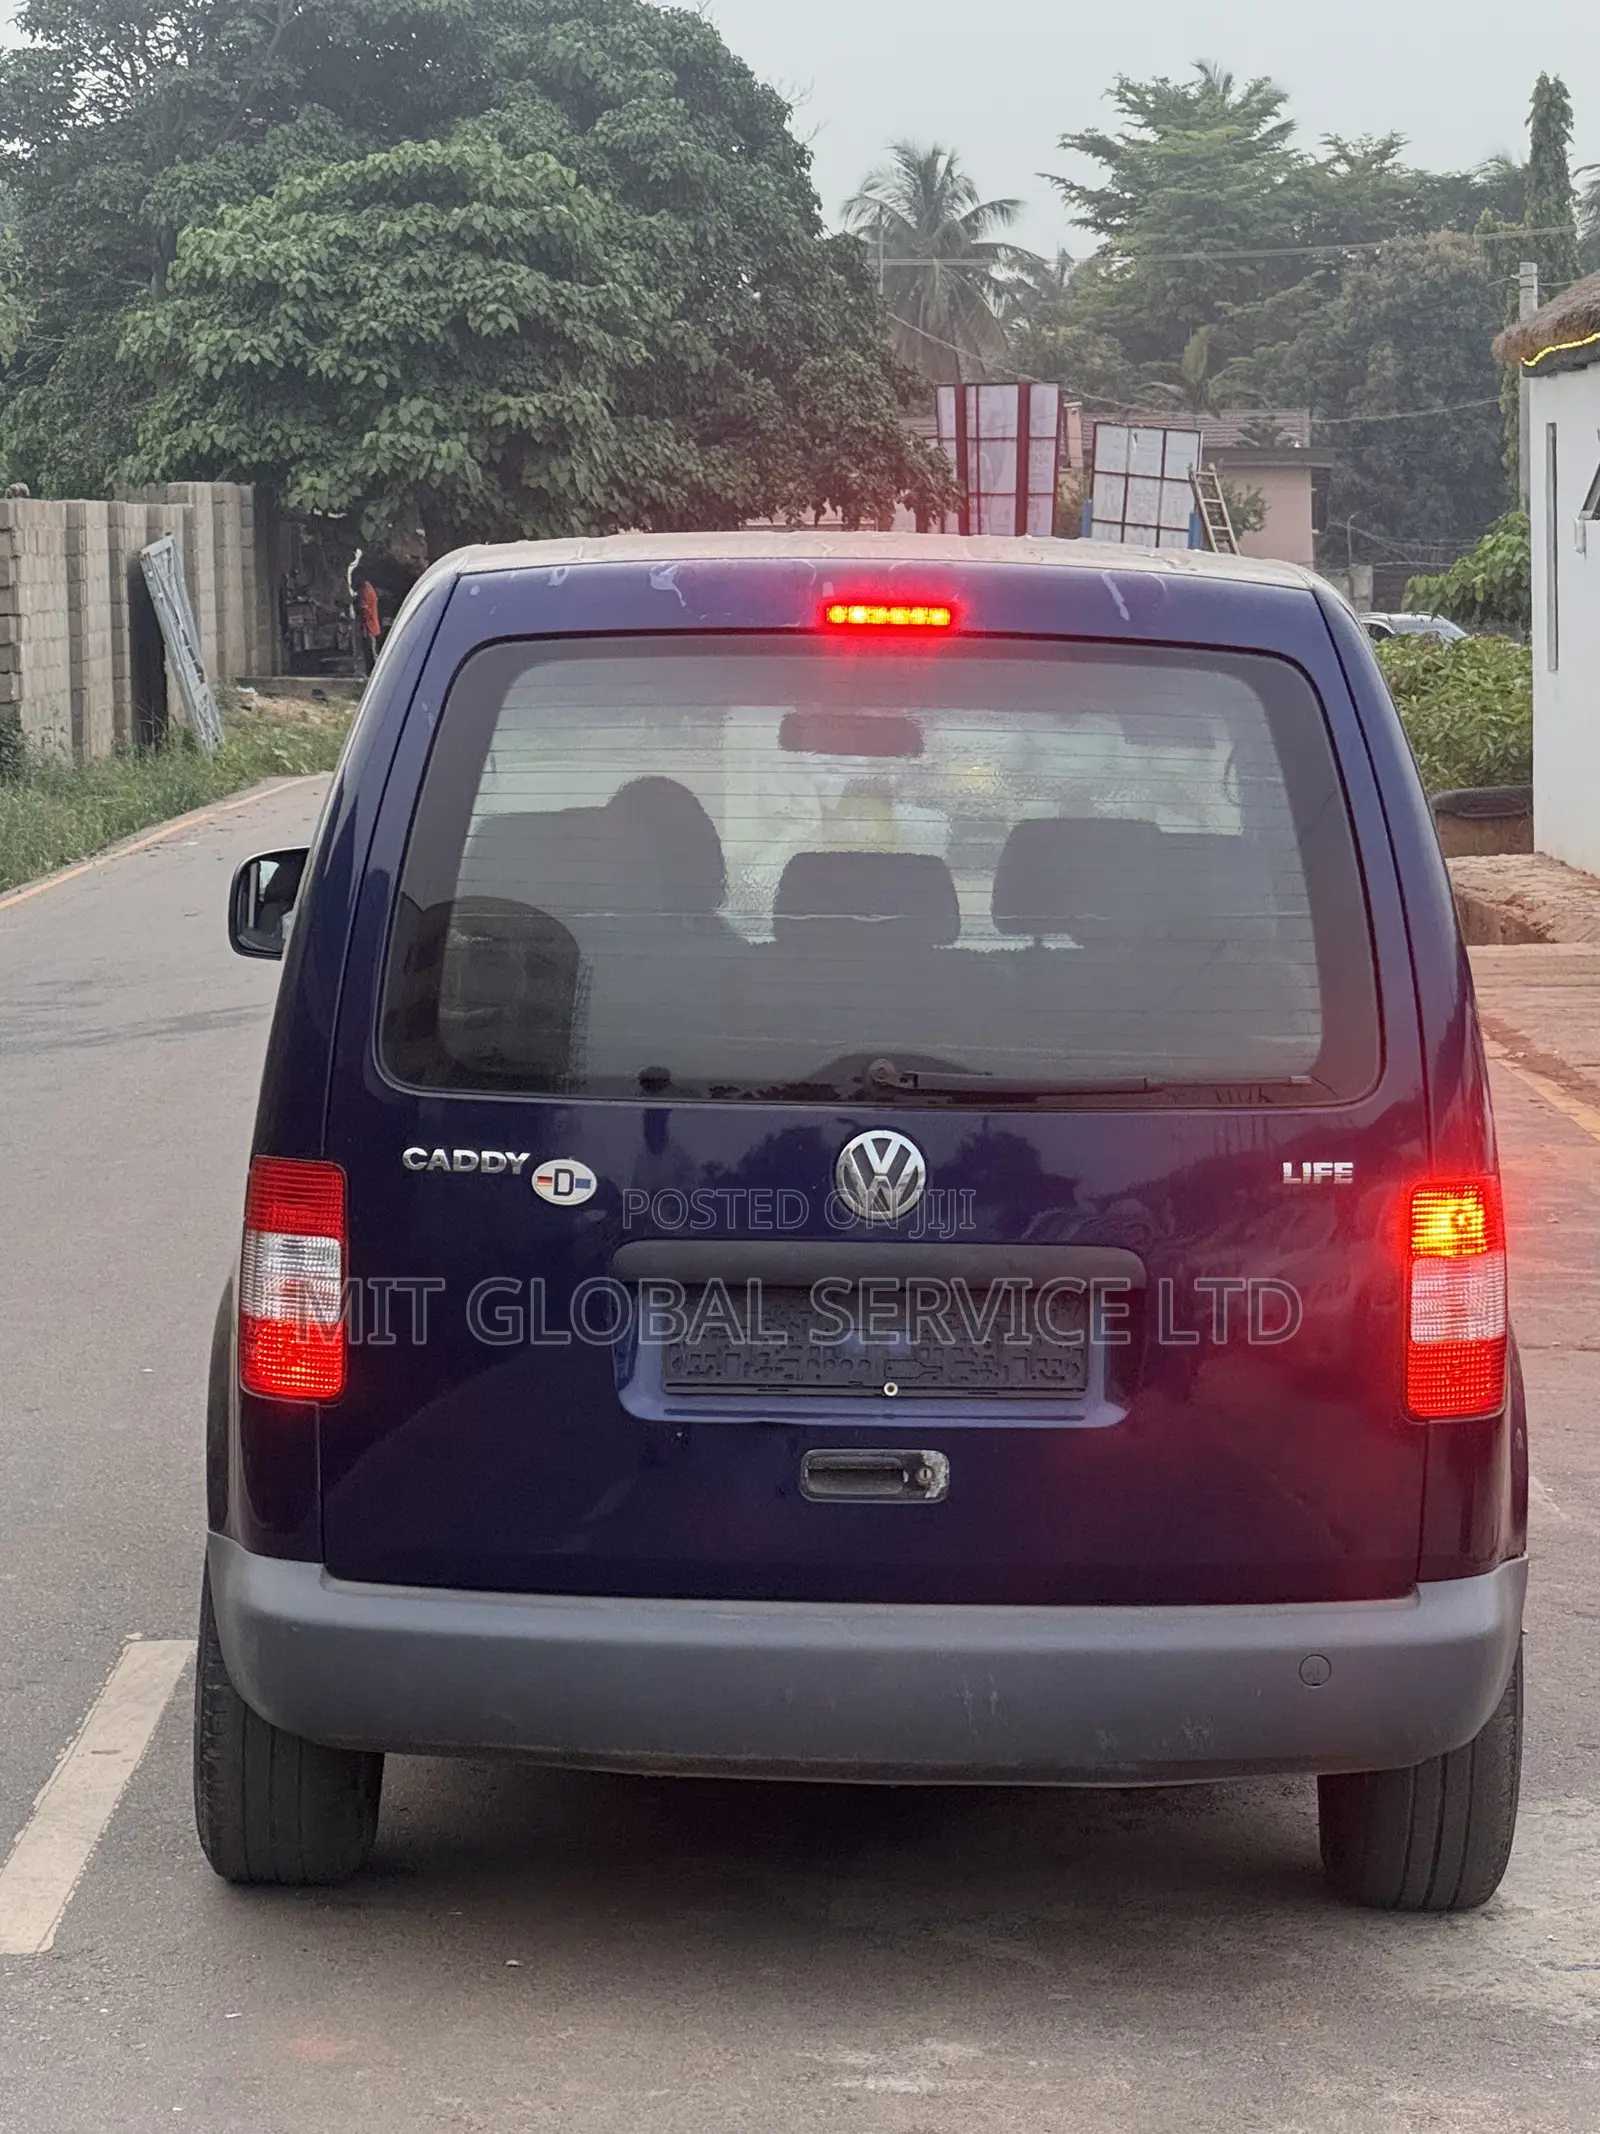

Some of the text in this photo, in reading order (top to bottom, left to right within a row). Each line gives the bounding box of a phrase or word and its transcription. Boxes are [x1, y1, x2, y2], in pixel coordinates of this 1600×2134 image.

[402, 1147, 530, 1175] CADDY
[837, 1130, 926, 1220] VW
[1283, 1162, 1354, 1184] LIFE
[553, 1168, 574, 1196] D
